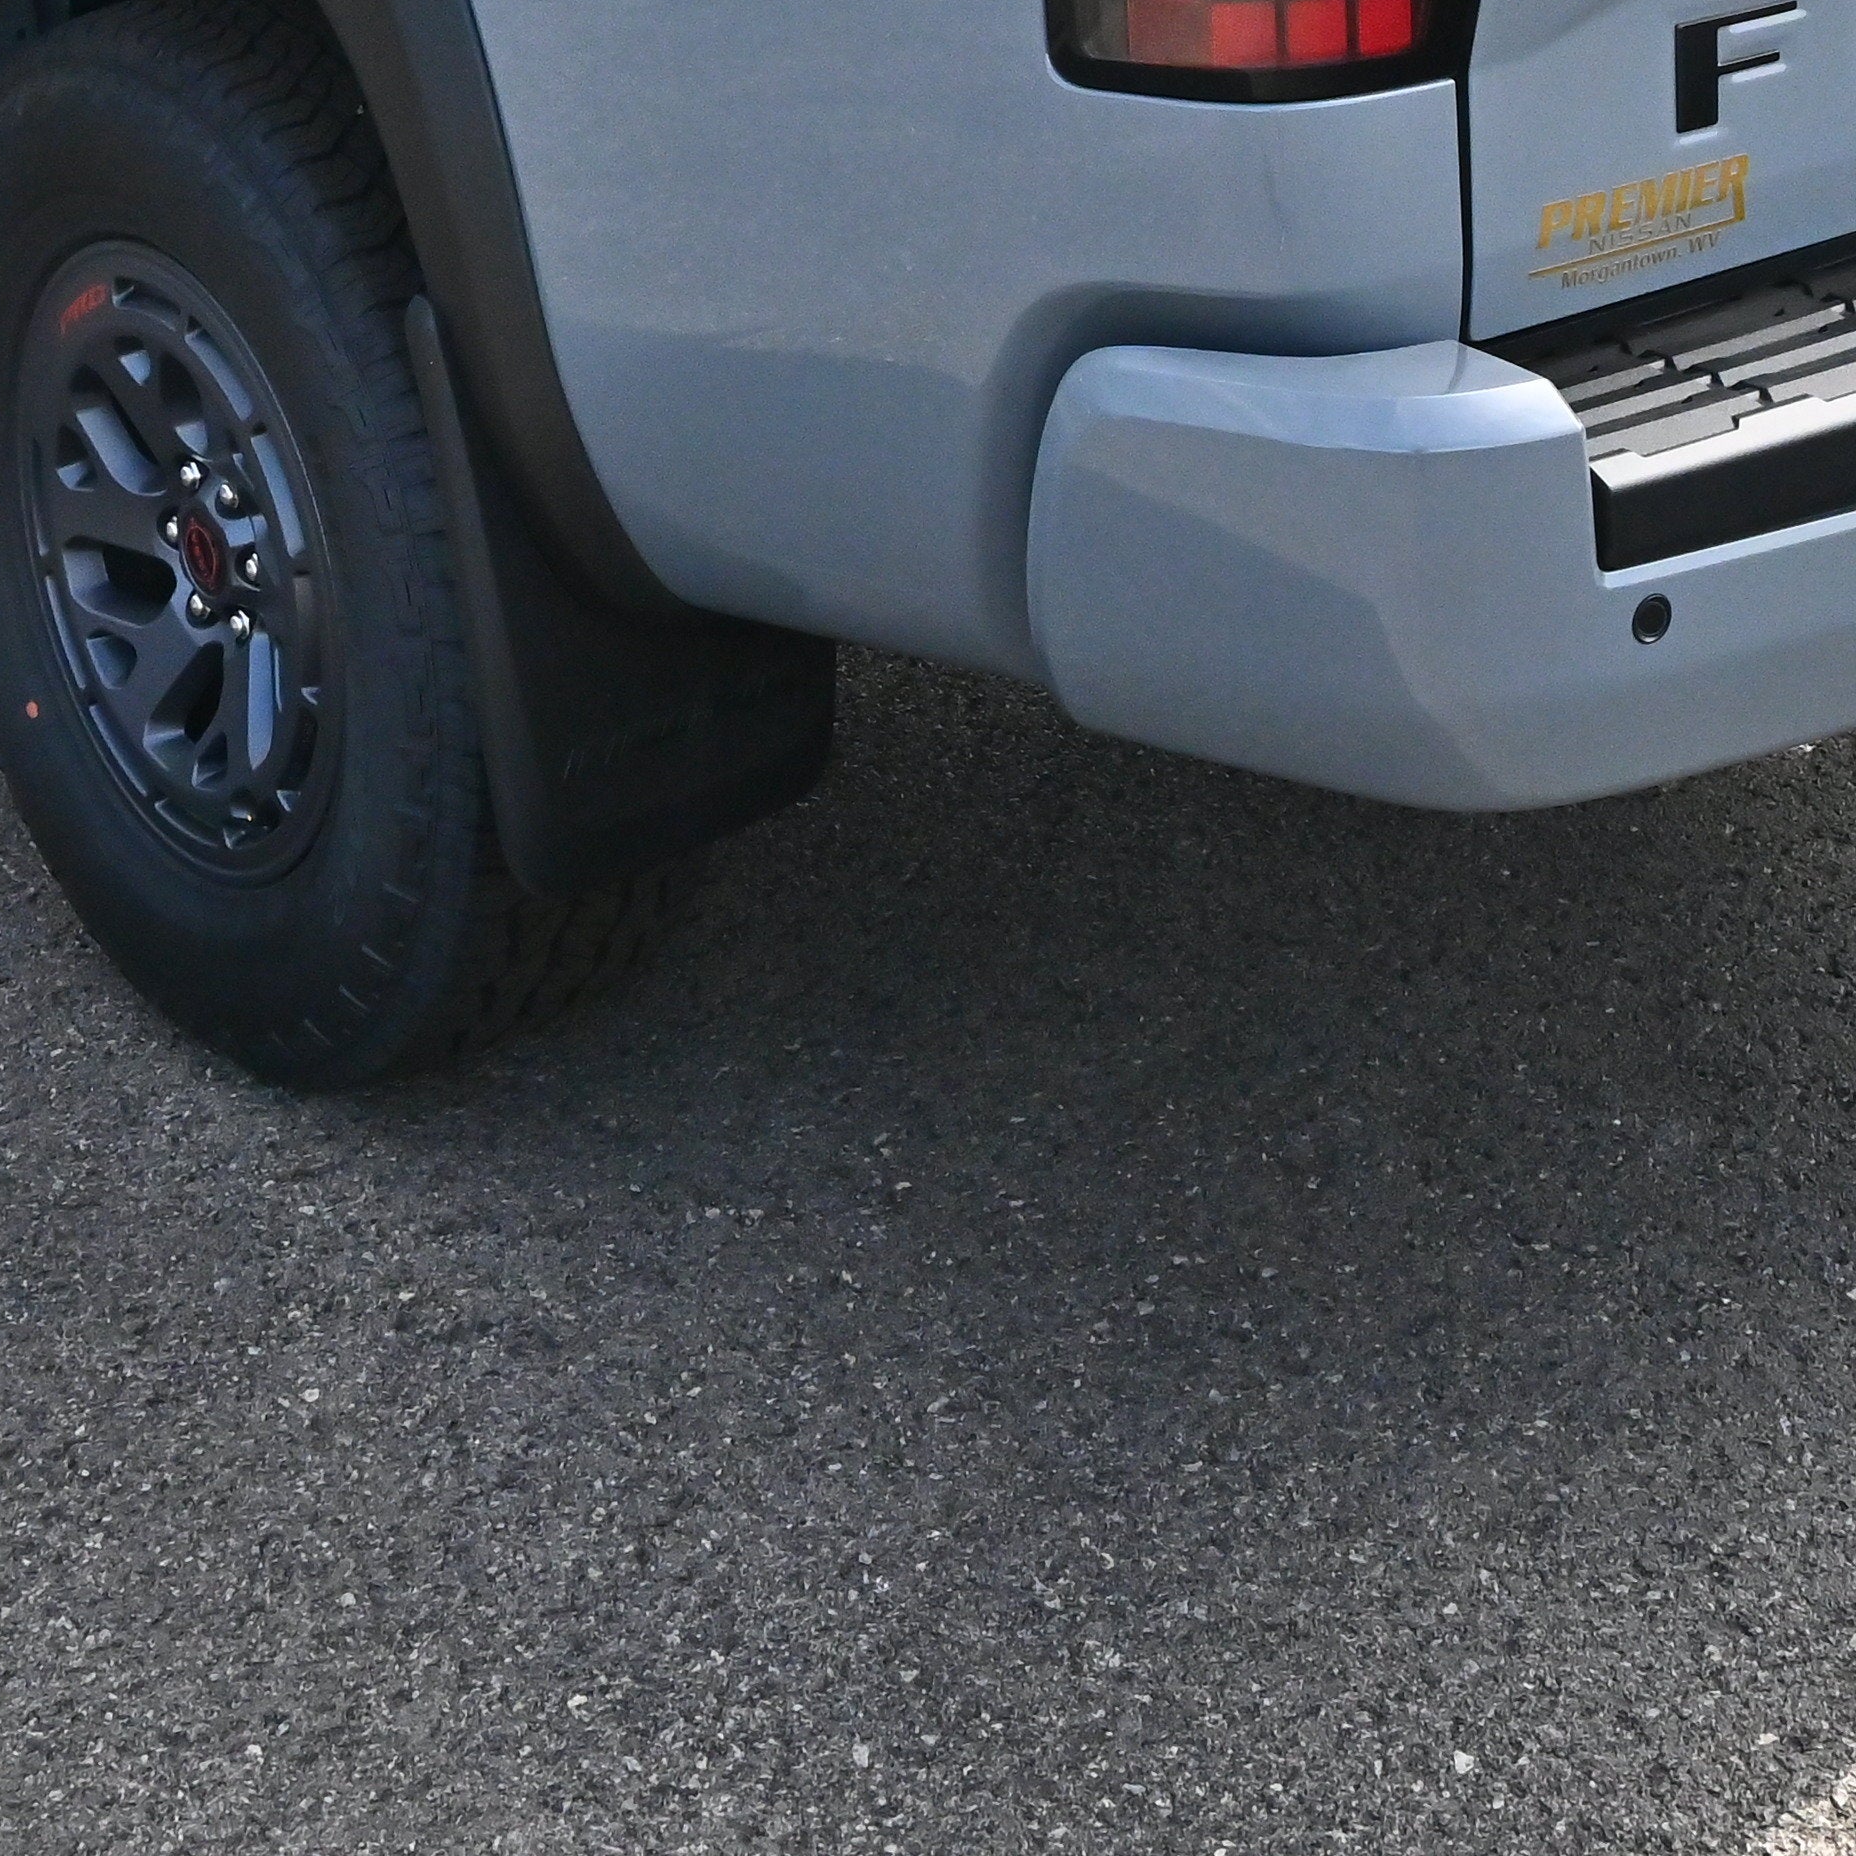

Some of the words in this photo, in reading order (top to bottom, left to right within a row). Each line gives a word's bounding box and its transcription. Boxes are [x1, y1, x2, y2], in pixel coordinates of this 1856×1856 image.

[1536, 153, 1750, 250] PREMIER
[1588, 212, 1692, 256] NISSAN
[1689, 231, 1722, 254] WV
